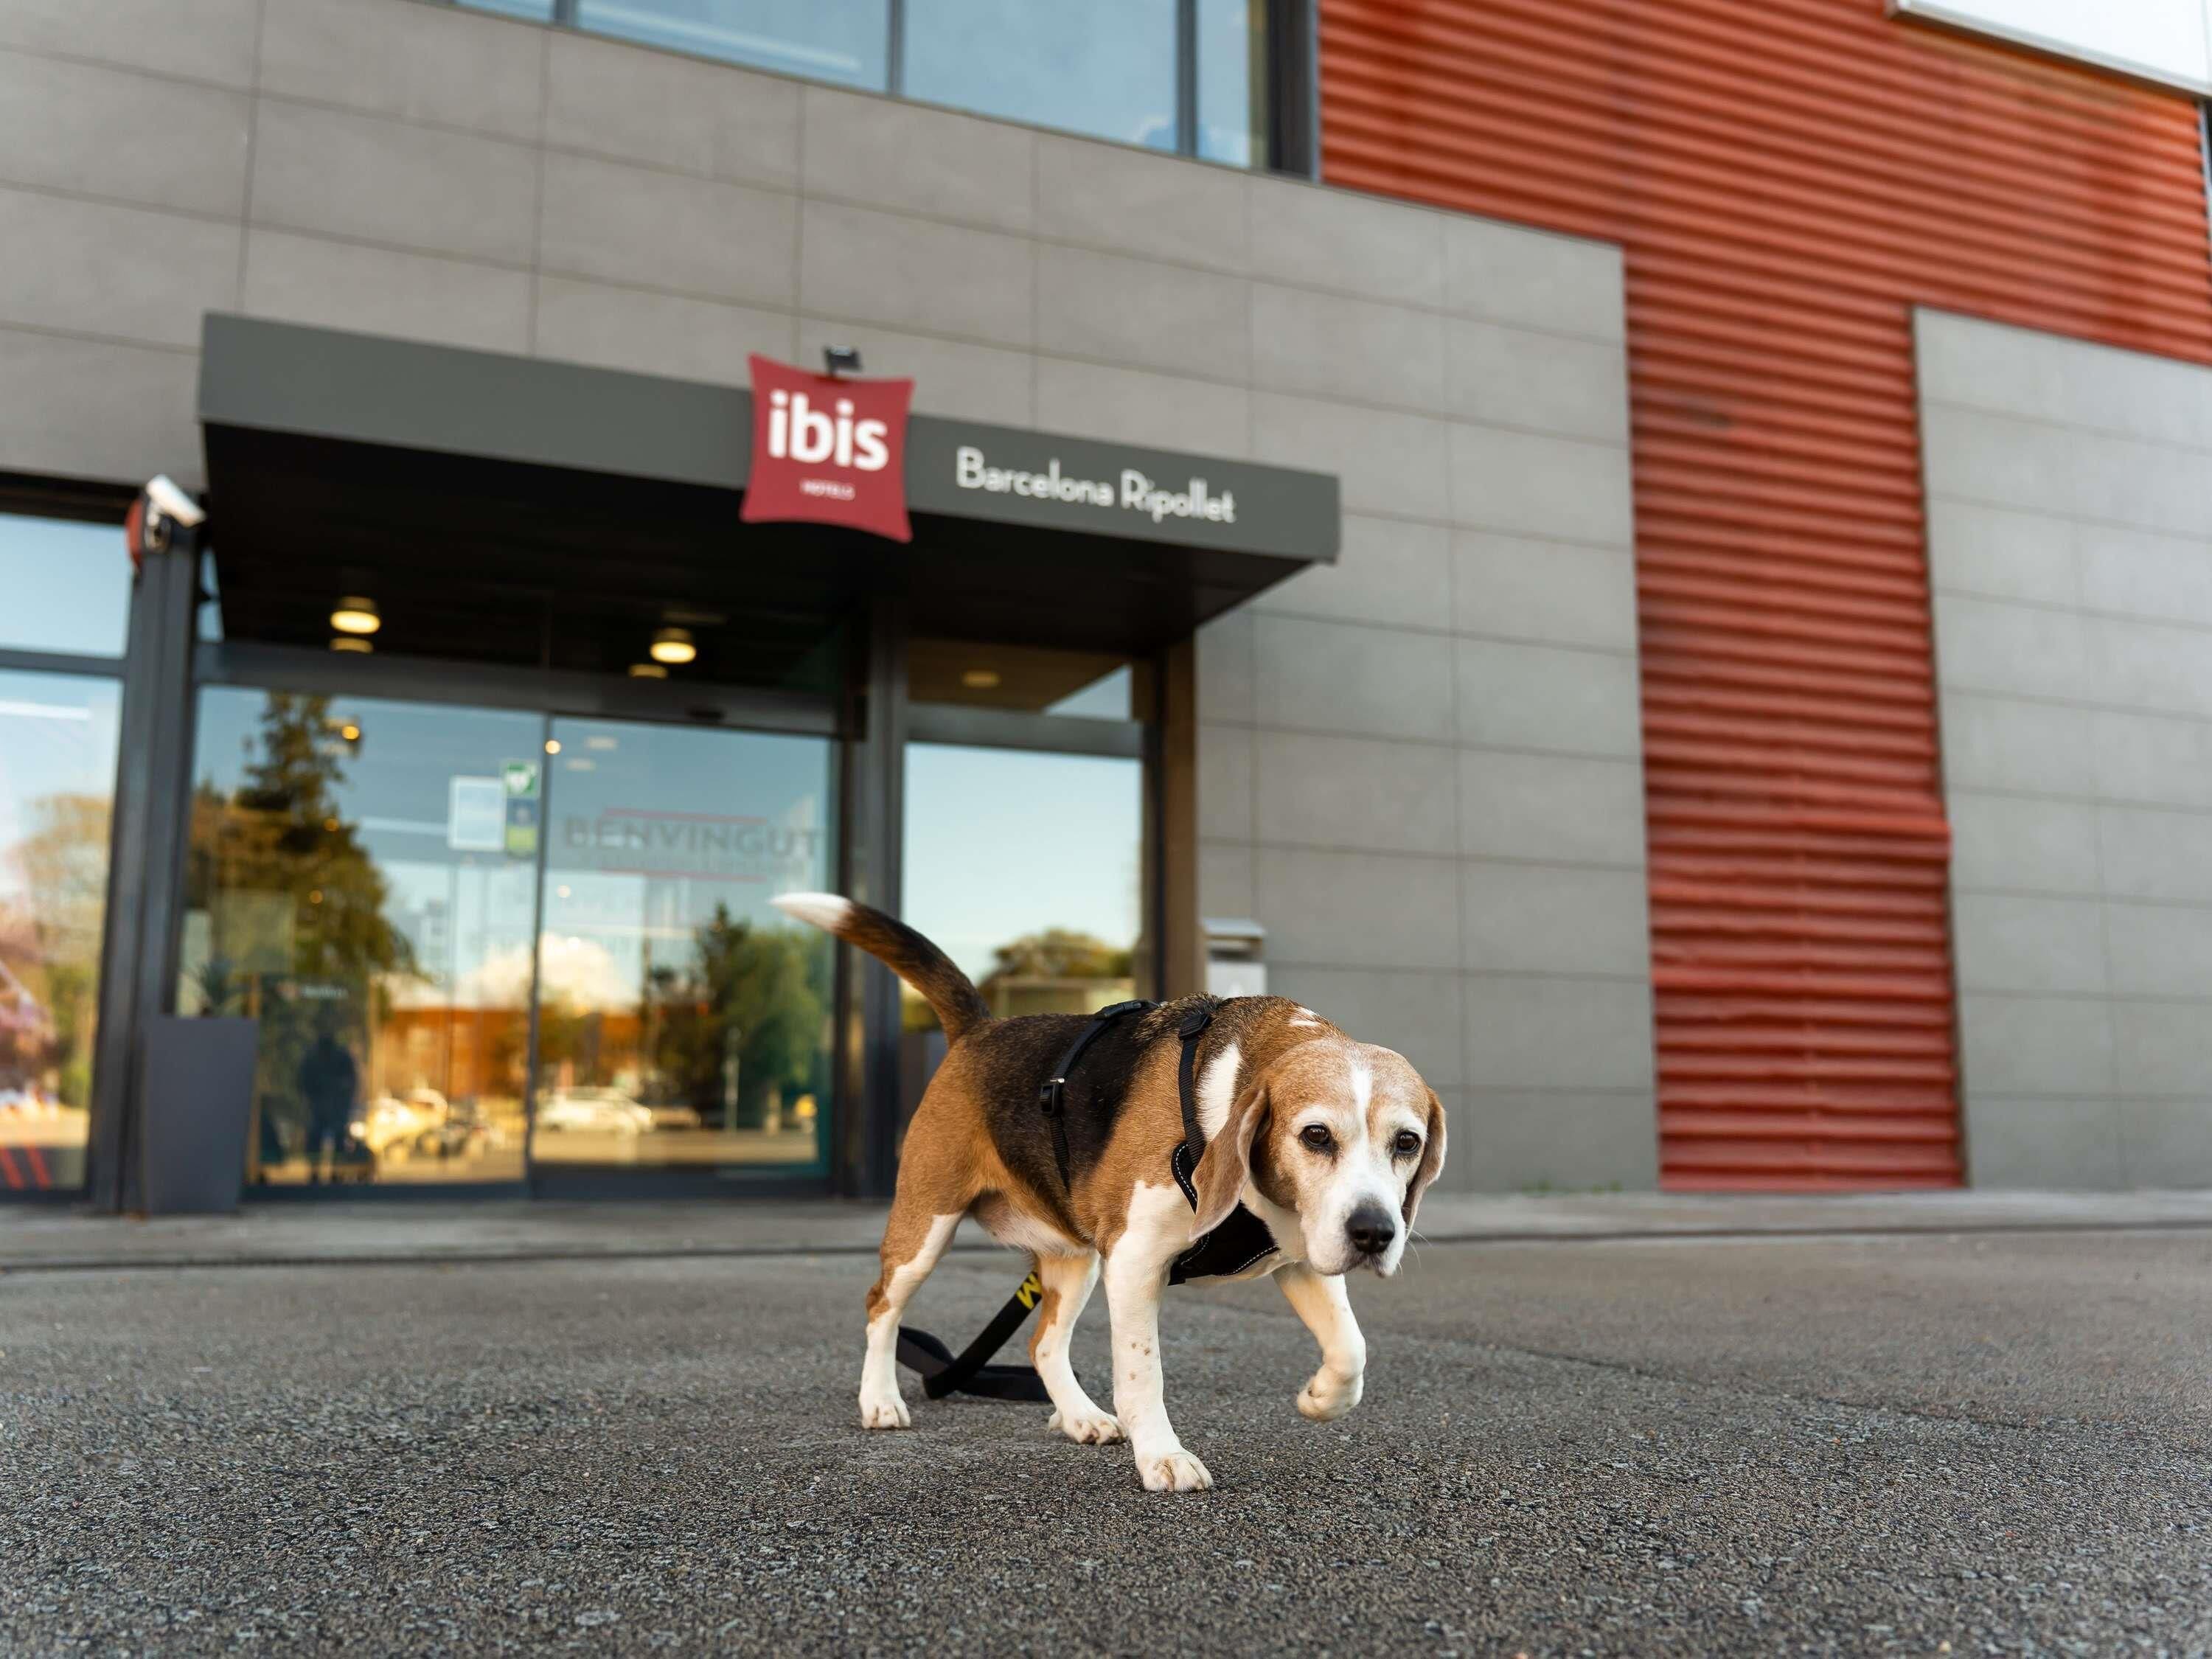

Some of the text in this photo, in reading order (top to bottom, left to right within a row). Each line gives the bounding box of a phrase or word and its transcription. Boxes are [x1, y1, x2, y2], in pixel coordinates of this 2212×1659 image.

[768, 389, 889, 472] ibis
[956, 445, 1237, 524] Barcelona Ripollet
